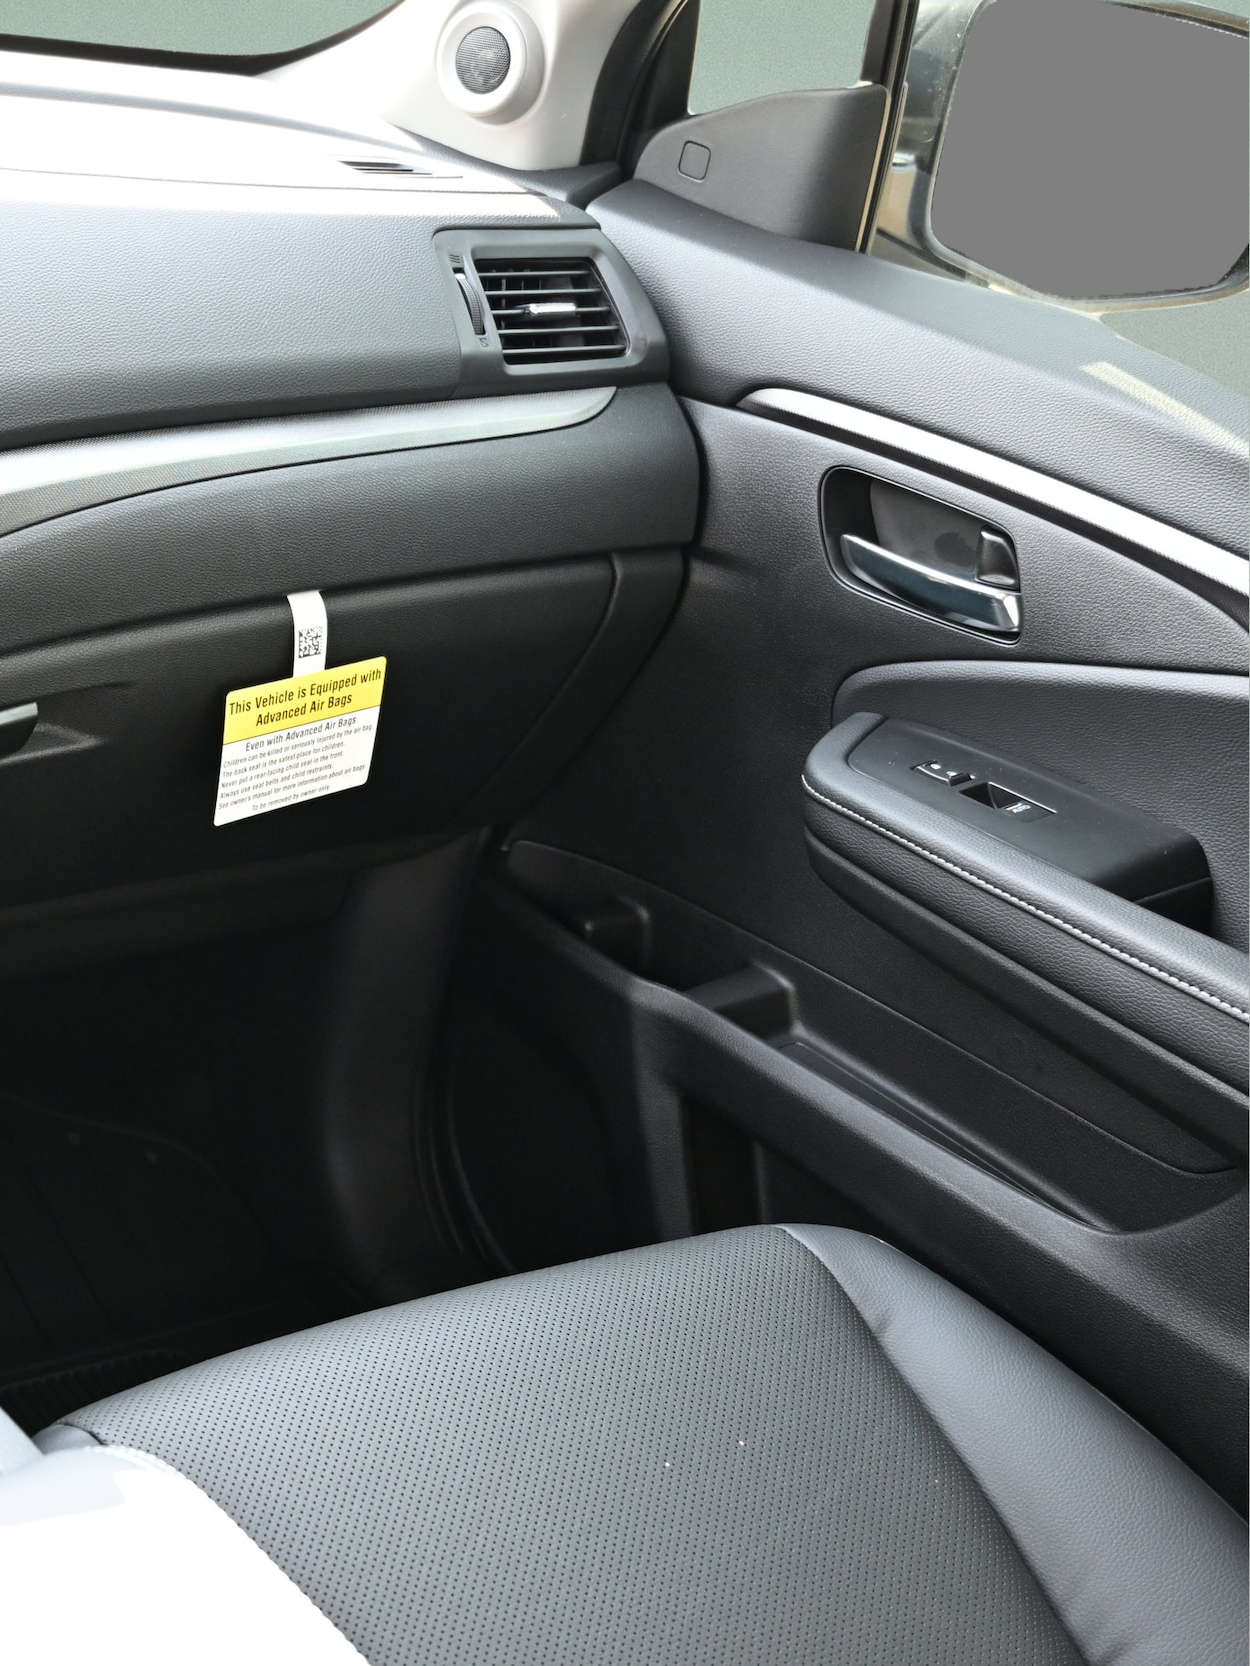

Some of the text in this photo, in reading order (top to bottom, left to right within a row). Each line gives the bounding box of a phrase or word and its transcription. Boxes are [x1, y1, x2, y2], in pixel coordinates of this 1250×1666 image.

[230, 668, 382, 715] This Vehicle is Equipped with
[256, 694, 352, 726] Advanced Air Bags
[246, 717, 356, 752] Even with Advanced Air Bags
